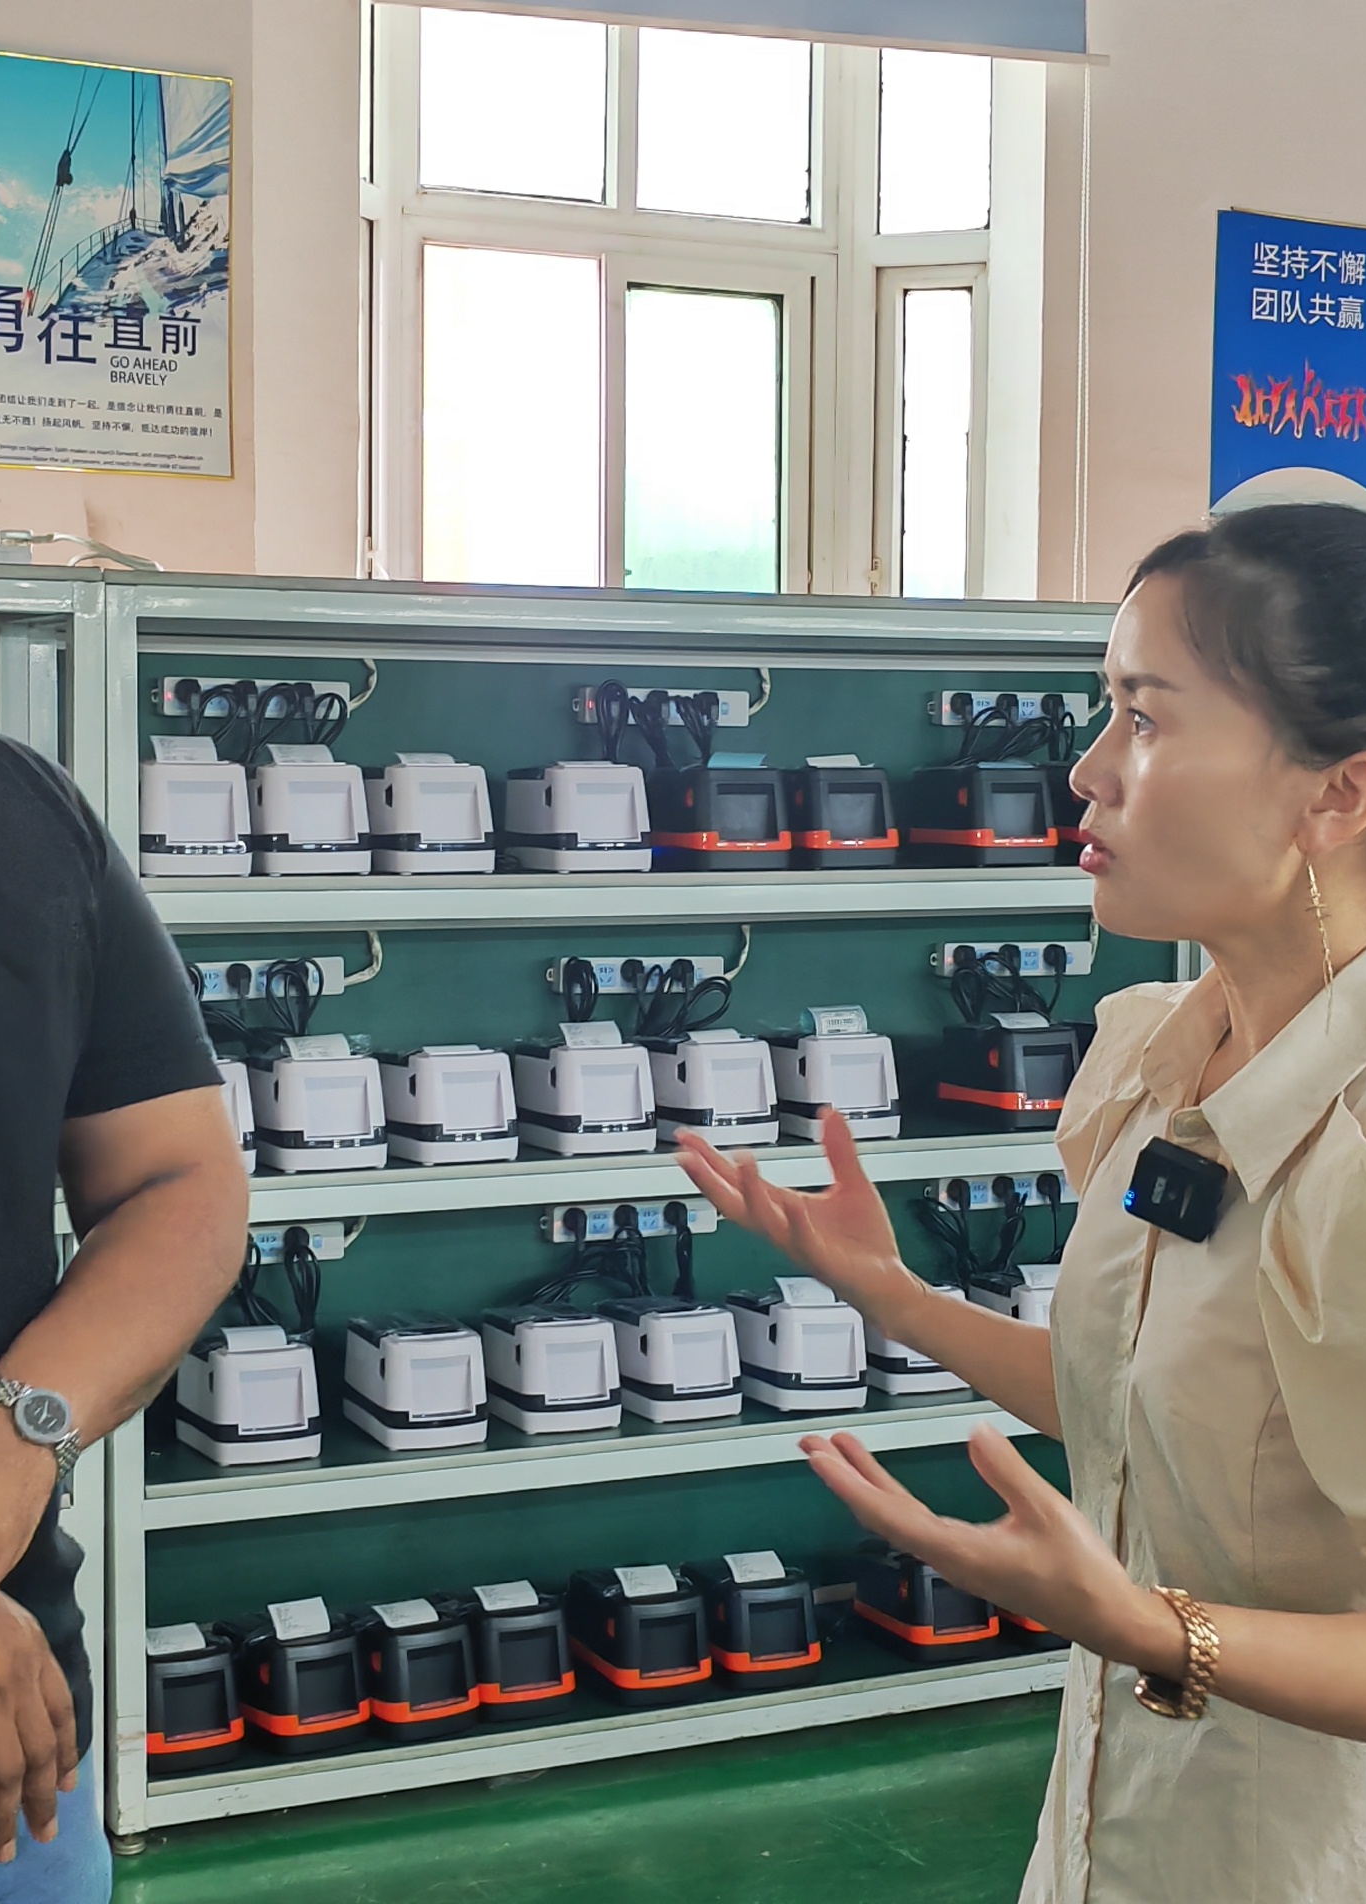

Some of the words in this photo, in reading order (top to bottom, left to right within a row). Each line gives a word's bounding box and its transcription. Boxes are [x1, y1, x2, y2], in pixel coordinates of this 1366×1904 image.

[1252, 241, 1366, 286] 坚持不懈
[1251, 287, 1365, 330] 团队共赢
[110, 355, 130, 369] GO
[133, 357, 178, 372] AHEAD
[110, 370, 167, 386] BRAVELY
